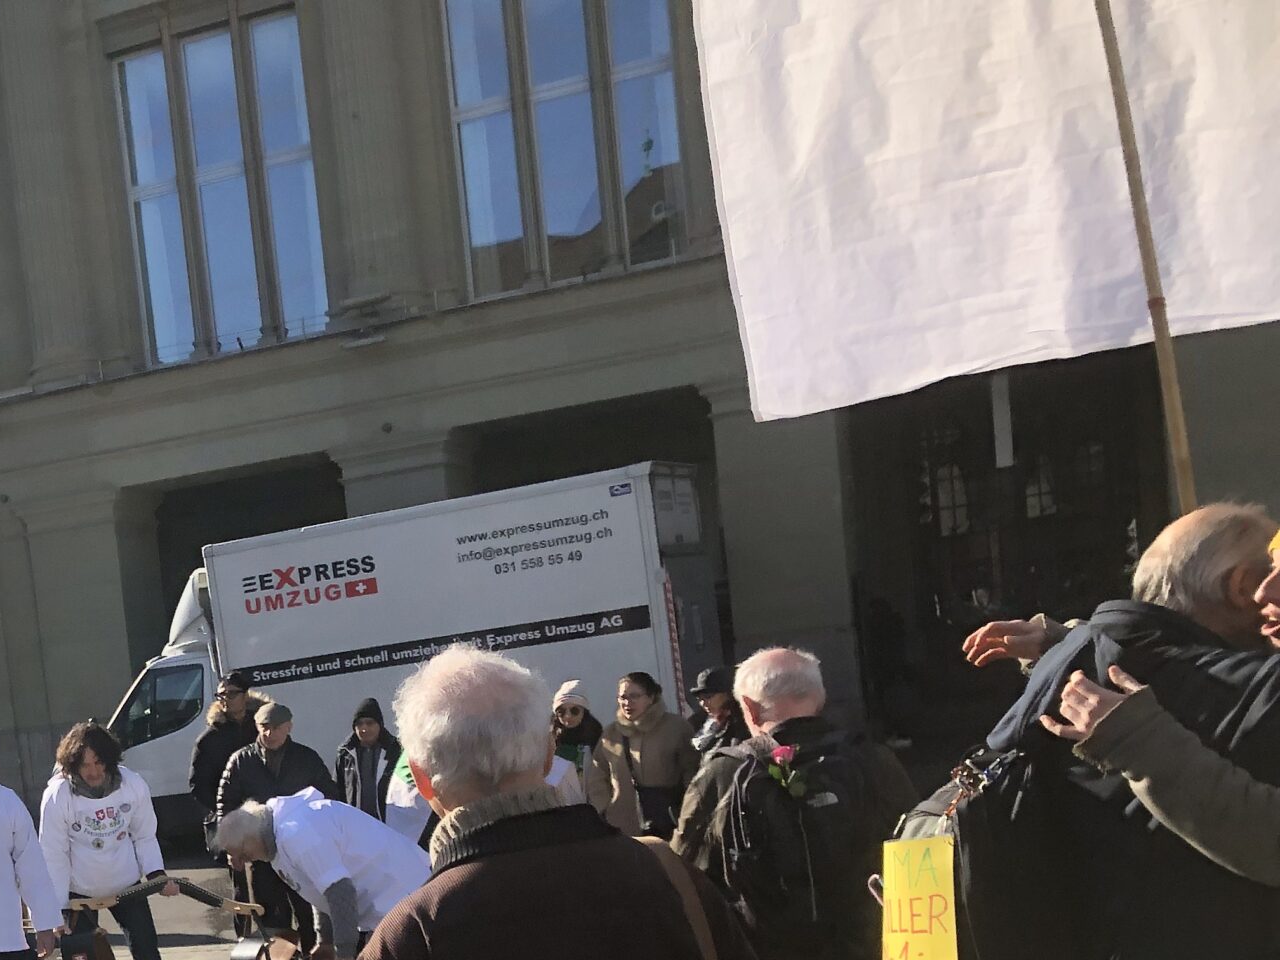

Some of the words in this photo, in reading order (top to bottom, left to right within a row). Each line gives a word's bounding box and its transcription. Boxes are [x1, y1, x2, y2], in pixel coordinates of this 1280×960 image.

[456, 509, 609, 545] www.expressumzug.ch
[457, 527, 613, 563] info@expressumzug.ch
[258, 555, 376, 591] EXPRESS
[494, 561, 516, 575] 031
[520, 556, 544, 571] 558
[548, 553, 563, 566] 55
[567, 550, 583, 562] 49
[245, 583, 342, 614] UMZUG
[252, 662, 313, 682] Stressfrei
[316, 658, 340, 672] und
[344, 650, 388, 668] schnell
[392, 642, 450, 660] umziehe
[486, 628, 541, 646] Express
[545, 621, 595, 637] Umzug
[600, 614, 623, 629] AG
